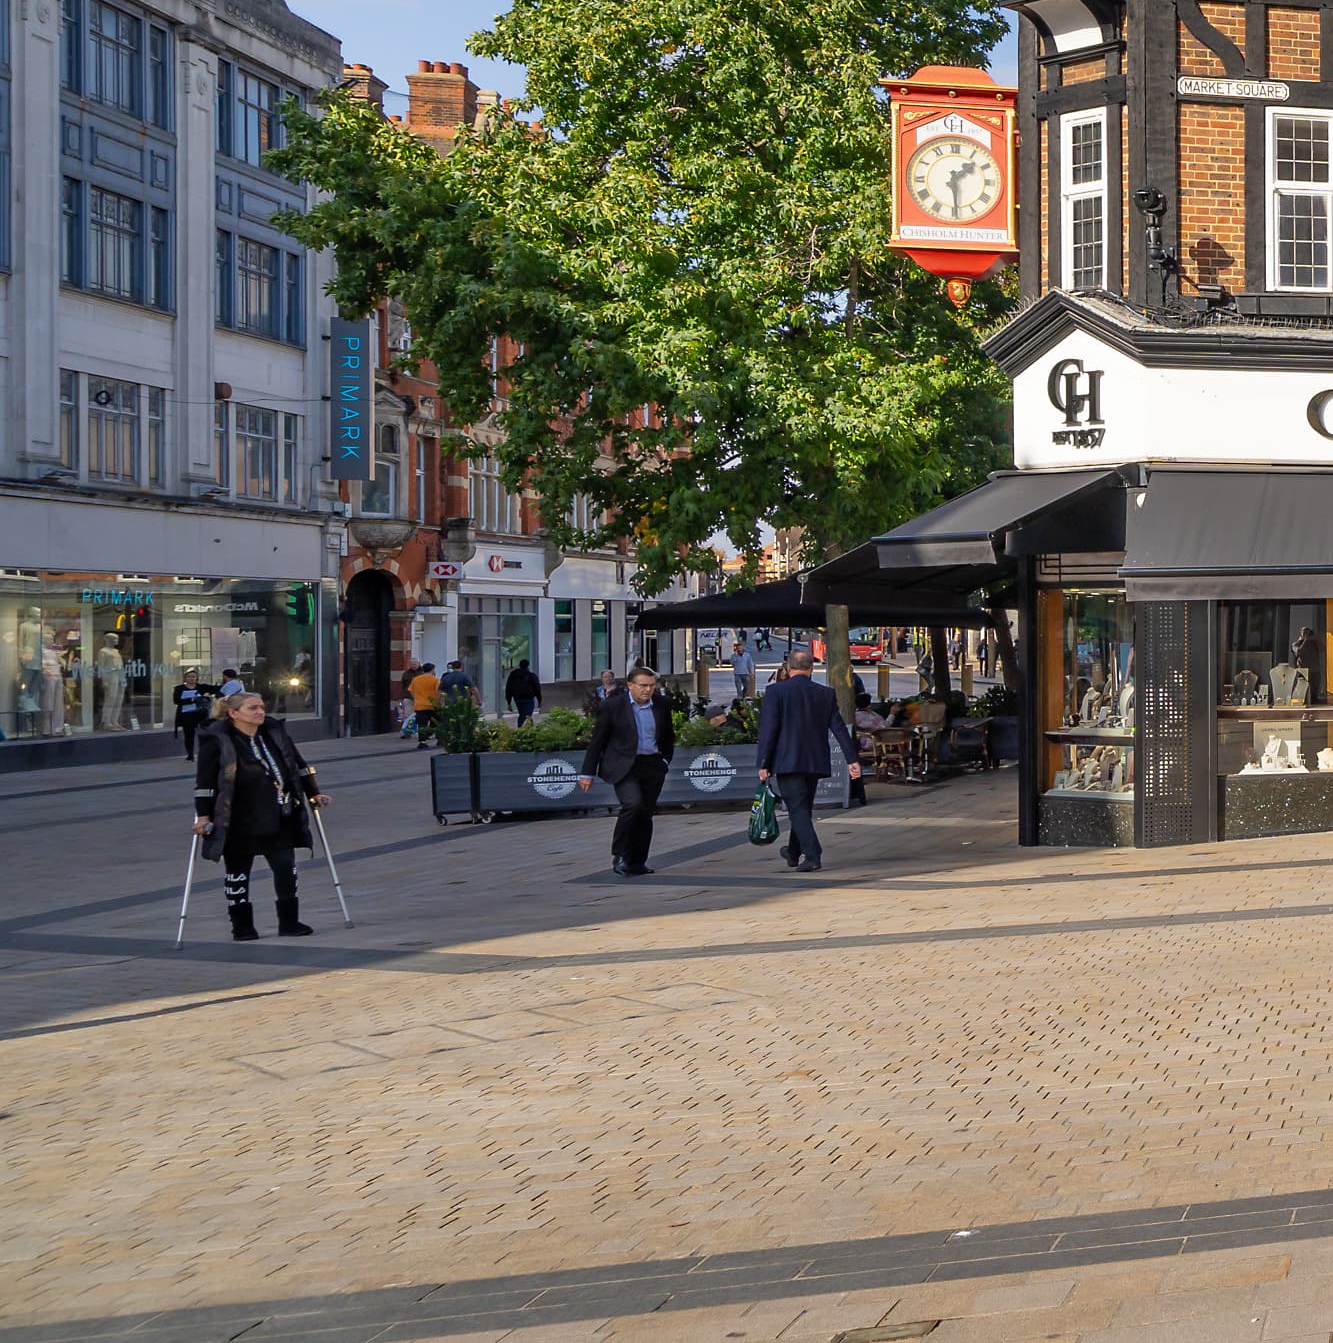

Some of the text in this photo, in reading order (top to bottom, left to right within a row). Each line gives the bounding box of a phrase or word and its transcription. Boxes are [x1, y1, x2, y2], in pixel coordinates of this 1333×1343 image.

[1184, 81, 1283, 98] MARKET SQUARE
[902, 226, 1004, 242] CHISHOLM HUNTER
[341, 337, 361, 459] PRIMARK
[81, 588, 155, 605] PRIMARK
[684, 768, 737, 777] STONEHENGE
